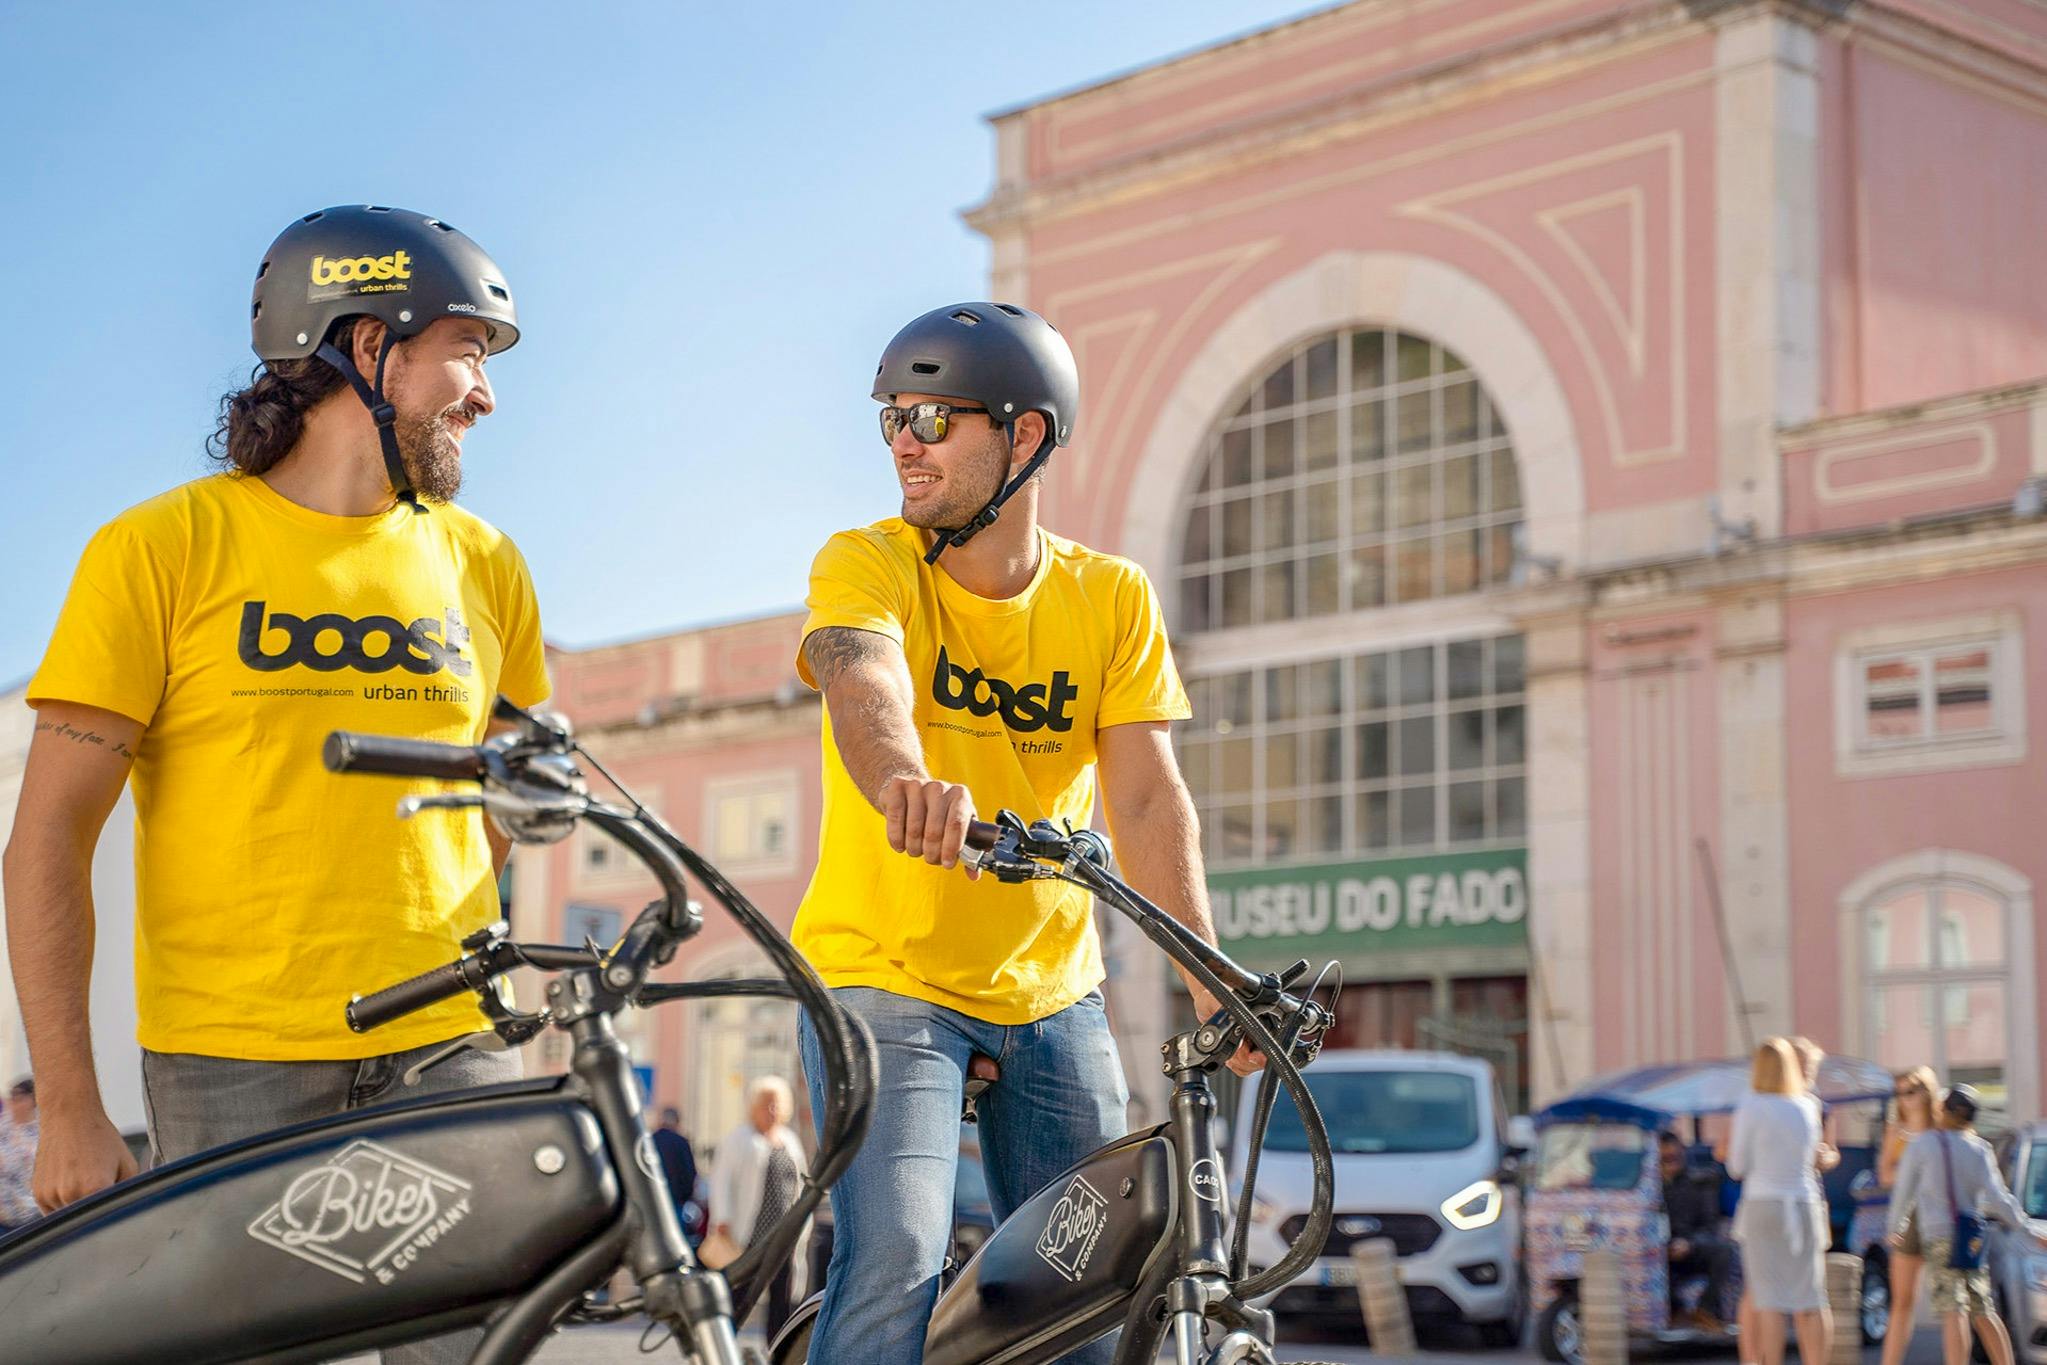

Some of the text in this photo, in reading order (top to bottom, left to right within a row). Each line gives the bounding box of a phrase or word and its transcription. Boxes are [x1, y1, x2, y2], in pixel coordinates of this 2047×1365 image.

[312, 250, 411, 286] boost
[385, 283, 408, 291] thrills
[238, 600, 472, 676] boost
[231, 684, 468, 702] www.boostportugal.com urban thrills
[932, 644, 1079, 733] boost
[1021, 740, 1063, 754] thrills
[1211, 867, 1527, 941] USEU DO FADO
[280, 1160, 437, 1246] Bikes
[392, 1198, 472, 1271] COMPANY
[1079, 1212, 1109, 1269] COMPANY
